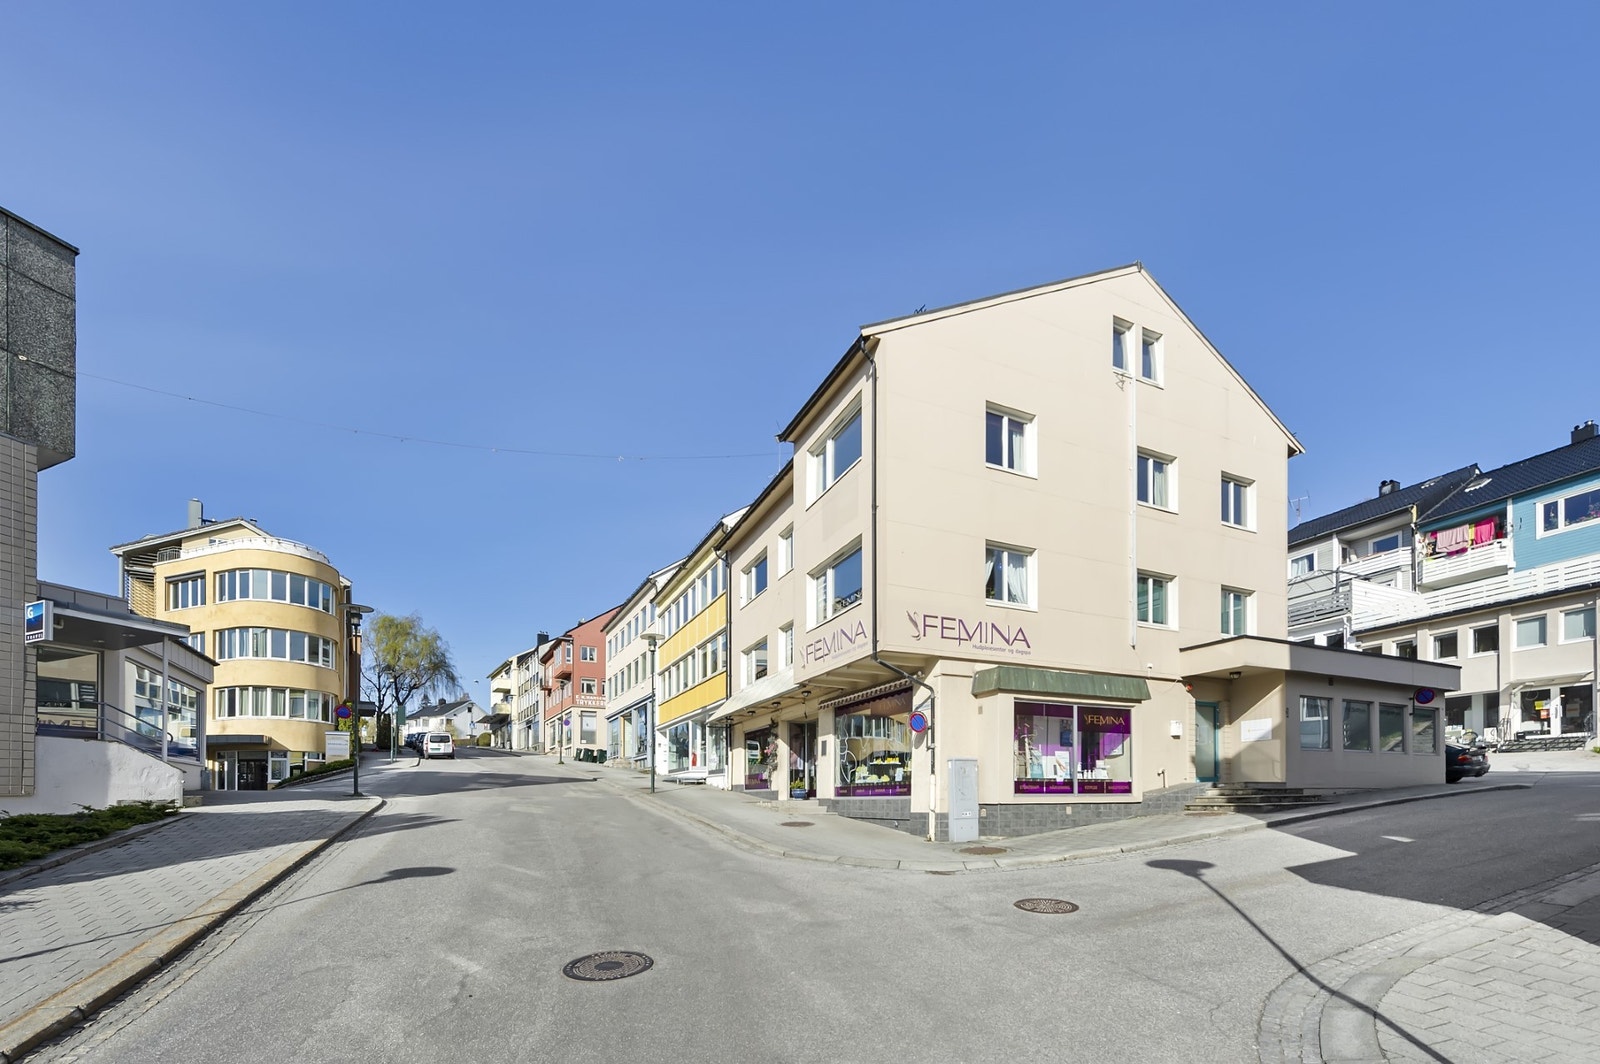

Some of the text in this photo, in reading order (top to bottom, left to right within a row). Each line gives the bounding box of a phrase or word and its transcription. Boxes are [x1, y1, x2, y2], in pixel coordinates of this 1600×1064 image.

[27, 606, 34, 619] G
[805, 620, 868, 664] FEMINA
[923, 613, 1031, 649] FEMINA
[1088, 714, 1125, 726] FEMINA
